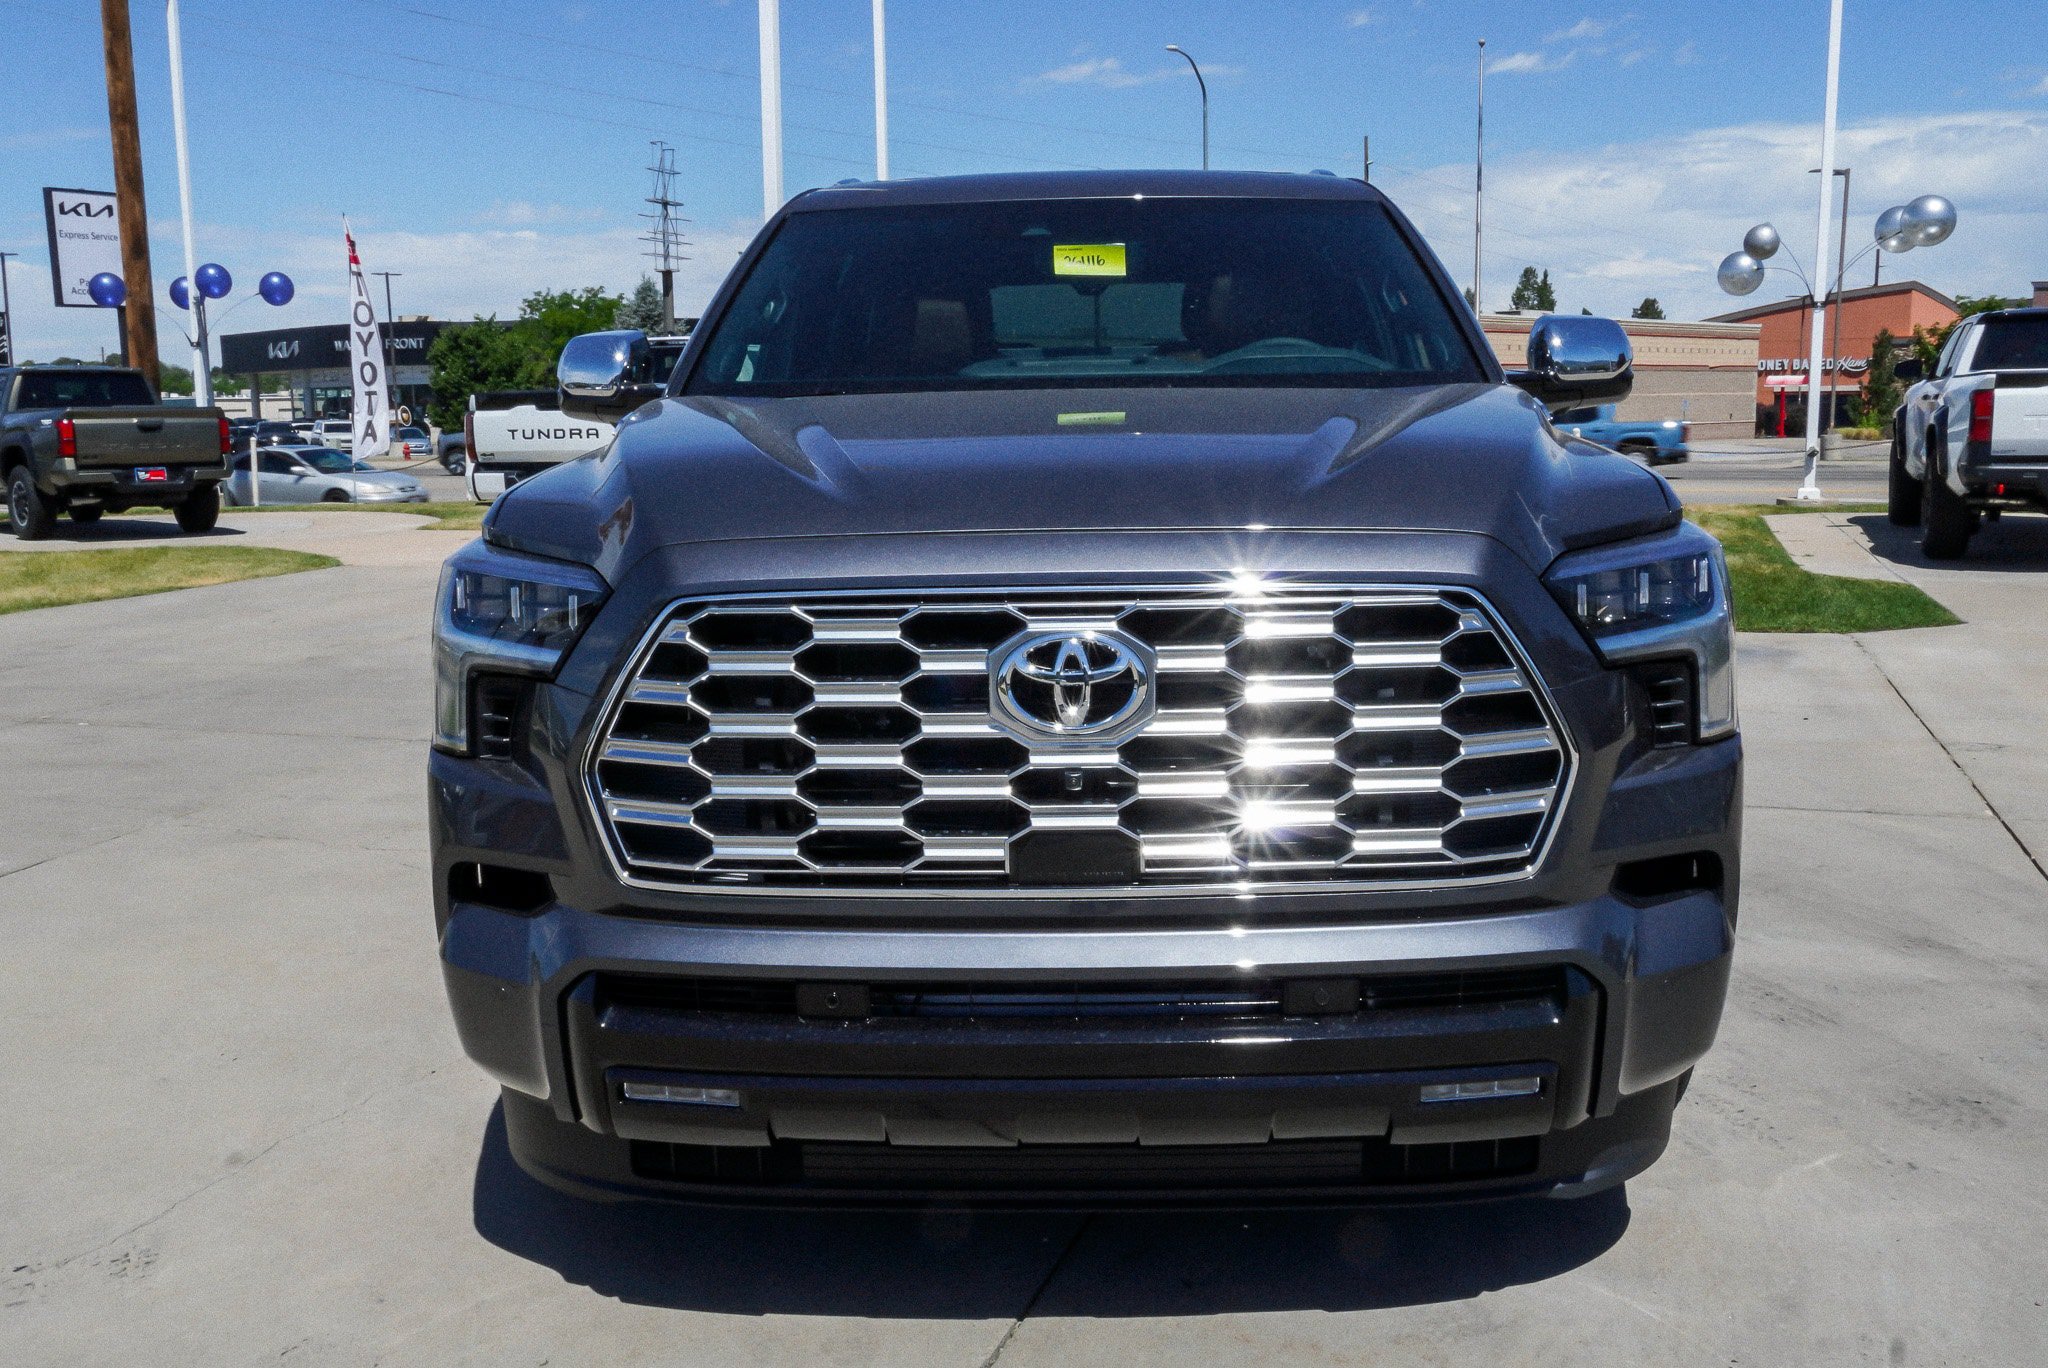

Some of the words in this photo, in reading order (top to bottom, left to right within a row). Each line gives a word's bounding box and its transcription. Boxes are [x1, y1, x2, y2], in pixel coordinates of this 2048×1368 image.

[59, 201, 113, 218] KIA
[59, 230, 89, 241] Express
[91, 232, 118, 242] Service
[351, 271, 378, 445] TOYOTA
[1758, 359, 1790, 370] ONEY
[1793, 358, 1834, 370] BAED
[507, 428, 600, 440] TUNDRA
